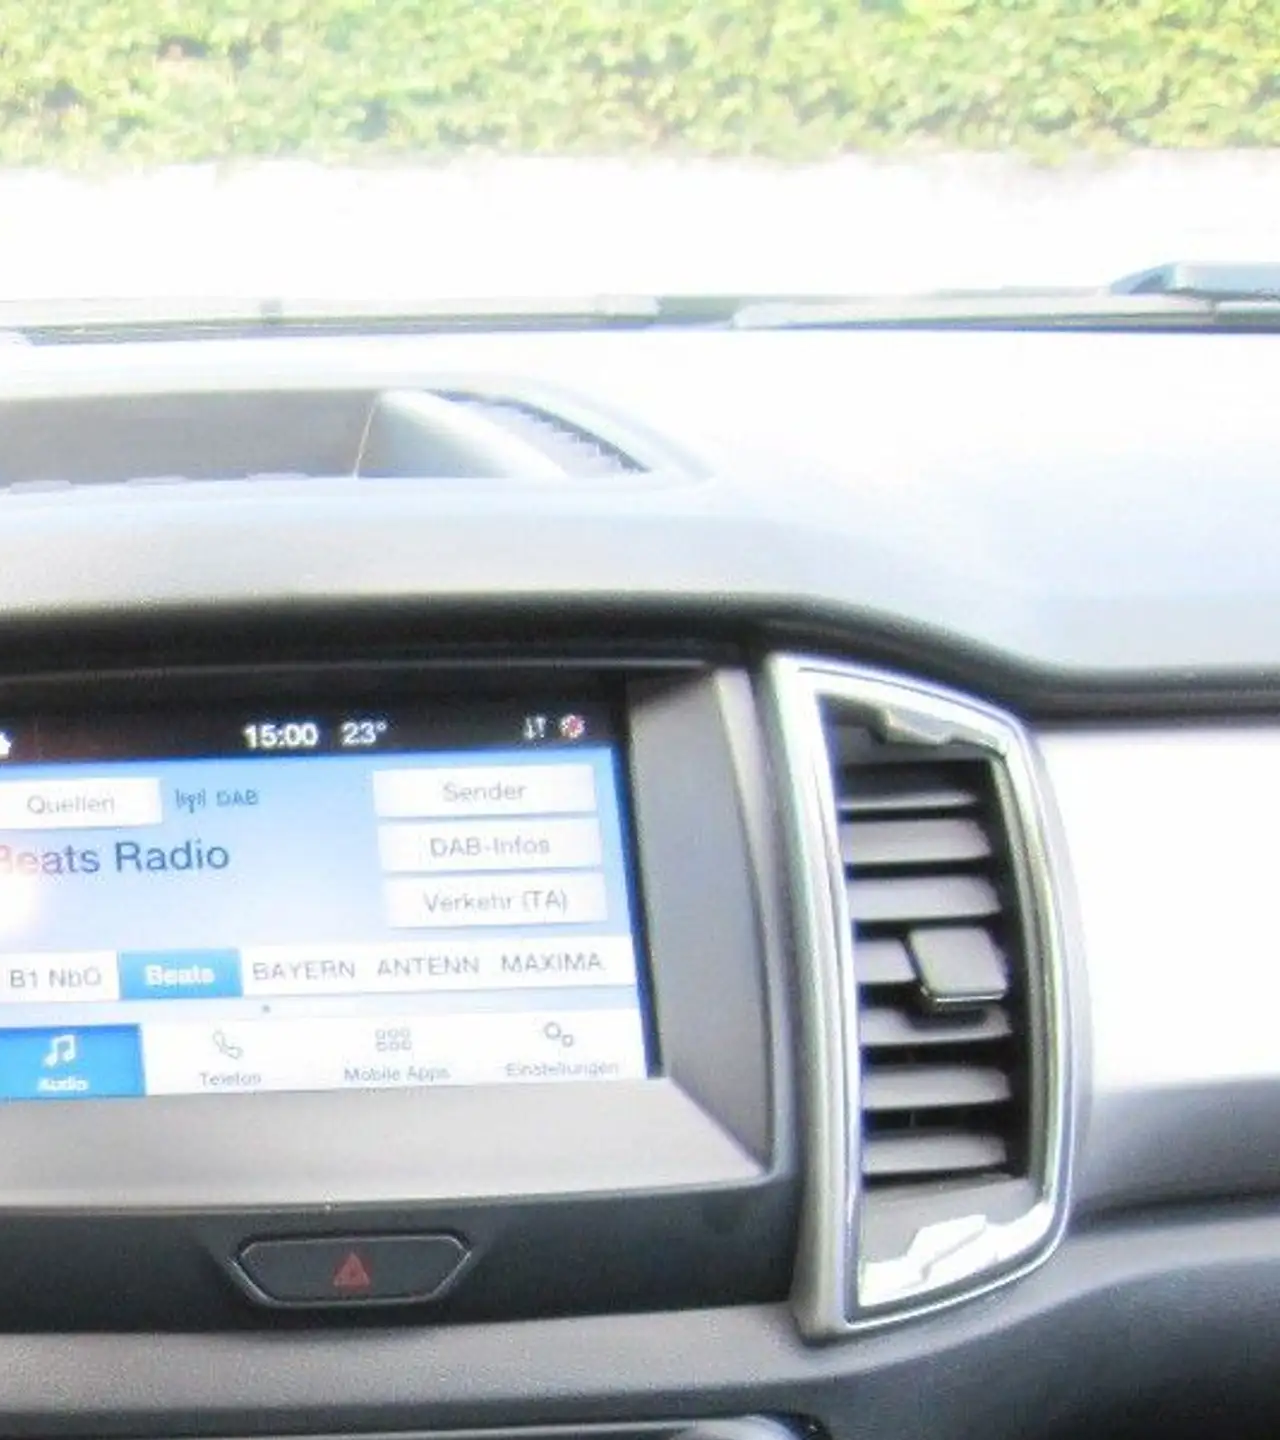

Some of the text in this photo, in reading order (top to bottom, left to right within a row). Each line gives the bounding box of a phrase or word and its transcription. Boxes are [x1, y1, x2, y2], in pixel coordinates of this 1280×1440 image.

[242, 723, 319, 748] 15:00
[216, 790, 260, 807] DAB
[443, 782, 528, 802] Sender
[26, 793, 116, 815] Quellen
[115, 838, 230, 872] Radio
[430, 836, 551, 858] DAB-Infos
[423, 889, 568, 914] Verkehr (TA)
[253, 958, 356, 981] BAYERN
[376, 956, 480, 977] ANTENN
[501, 952, 606, 974] MAXIMA
[10, 969, 40, 988] B1
[145, 965, 216, 985] Beats
[200, 1071, 262, 1088] Telefon
[344, 1064, 452, 1083] Mobile Apps
[505, 1061, 619, 1080] Einstellungen
[39, 1077, 88, 1092] Audio
